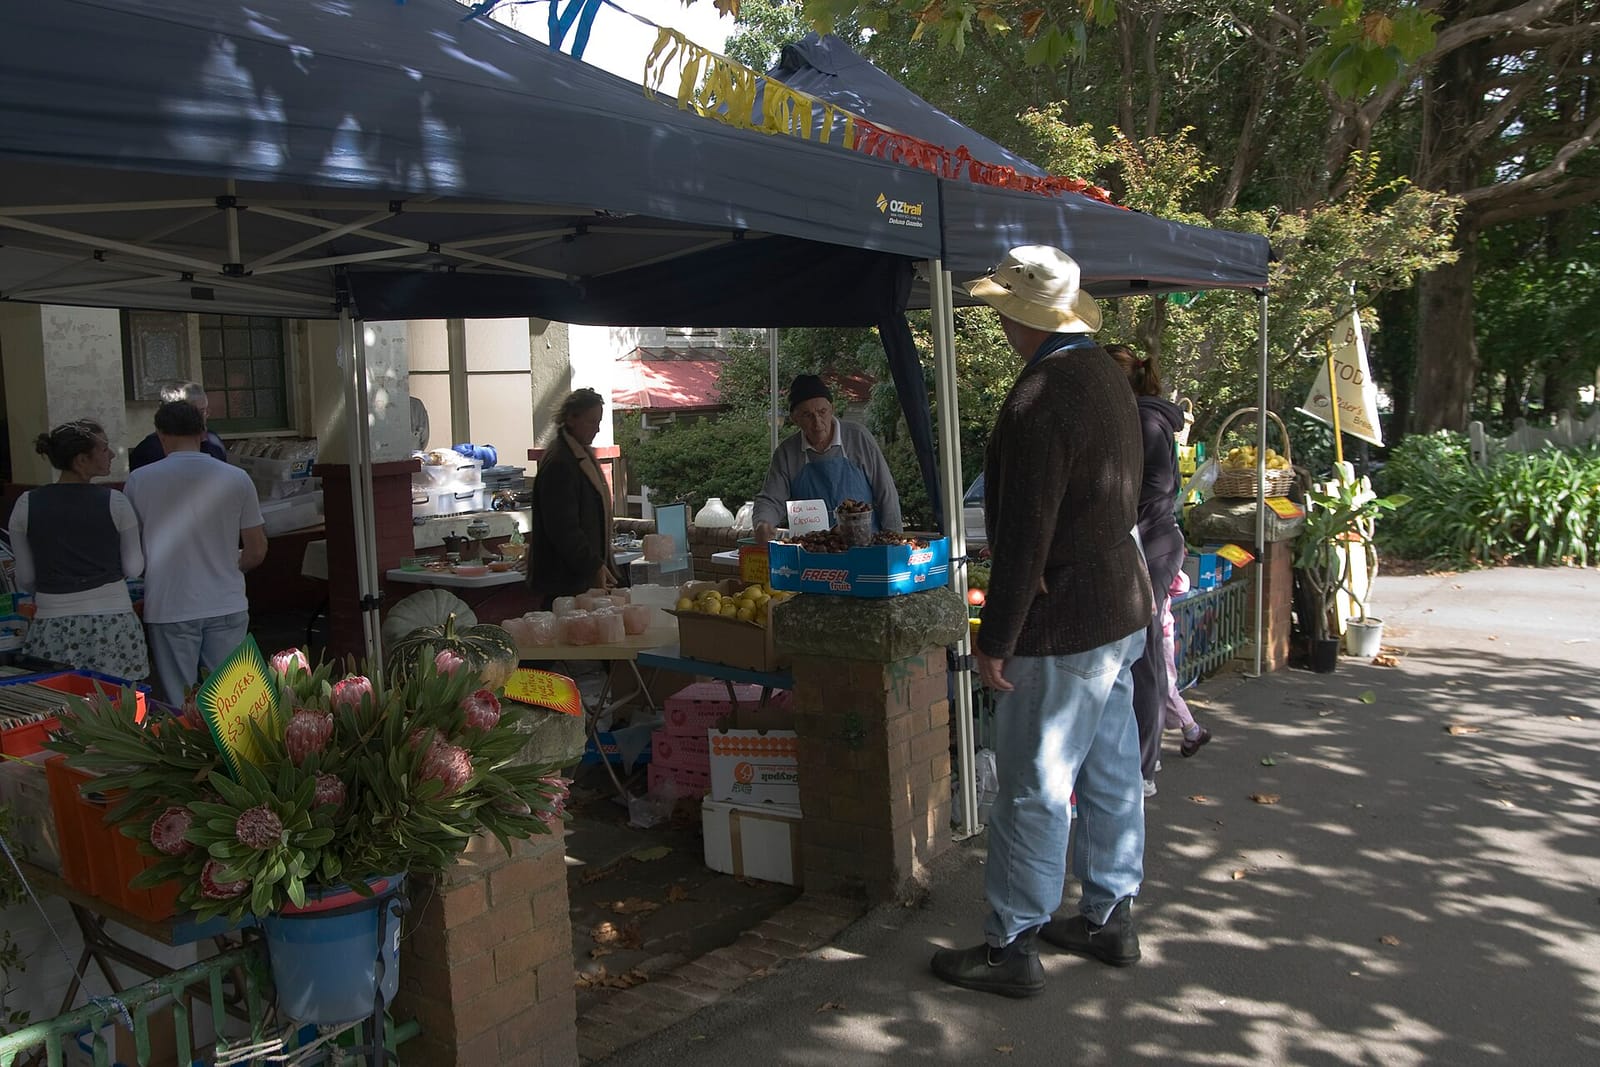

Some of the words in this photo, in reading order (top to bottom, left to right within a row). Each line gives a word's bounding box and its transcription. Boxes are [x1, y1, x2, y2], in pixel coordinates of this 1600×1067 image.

[801, 568, 848, 582] FRESH
[831, 580, 851, 591] fruit
[216, 672, 256, 721] PROTEAS
[227, 715, 246, 743] $3
[248, 691, 271, 720] EACH
